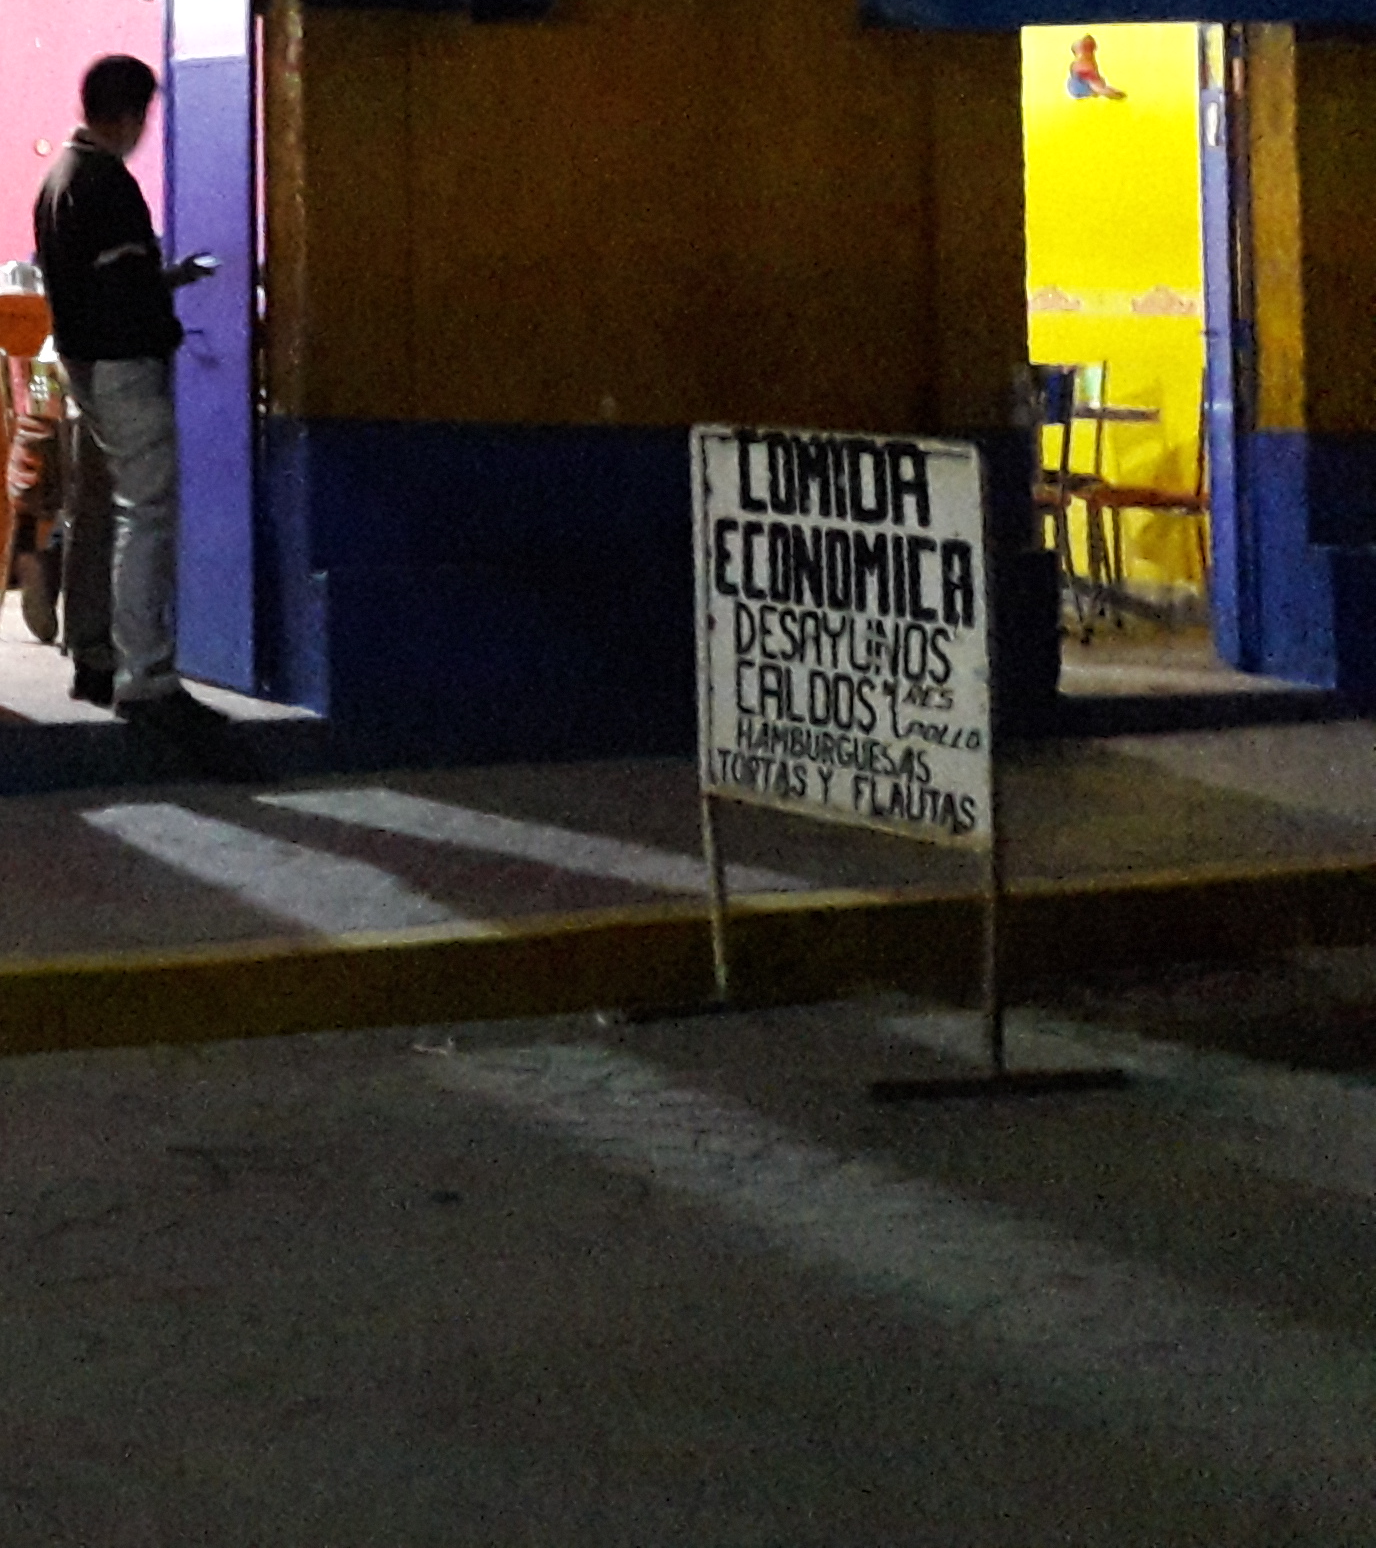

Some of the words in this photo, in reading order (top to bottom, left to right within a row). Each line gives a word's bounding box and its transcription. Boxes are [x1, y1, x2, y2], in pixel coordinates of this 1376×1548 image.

[734, 428, 931, 528] COMIDA
[715, 516, 975, 629] ECONOMICA
[734, 601, 952, 685] DESAYUNOS
[736, 657, 877, 736] CALDOS
[716, 746, 808, 798] TORTAS
[818, 765, 835, 805] Y
[852, 772, 976, 835] FLAUTAS
